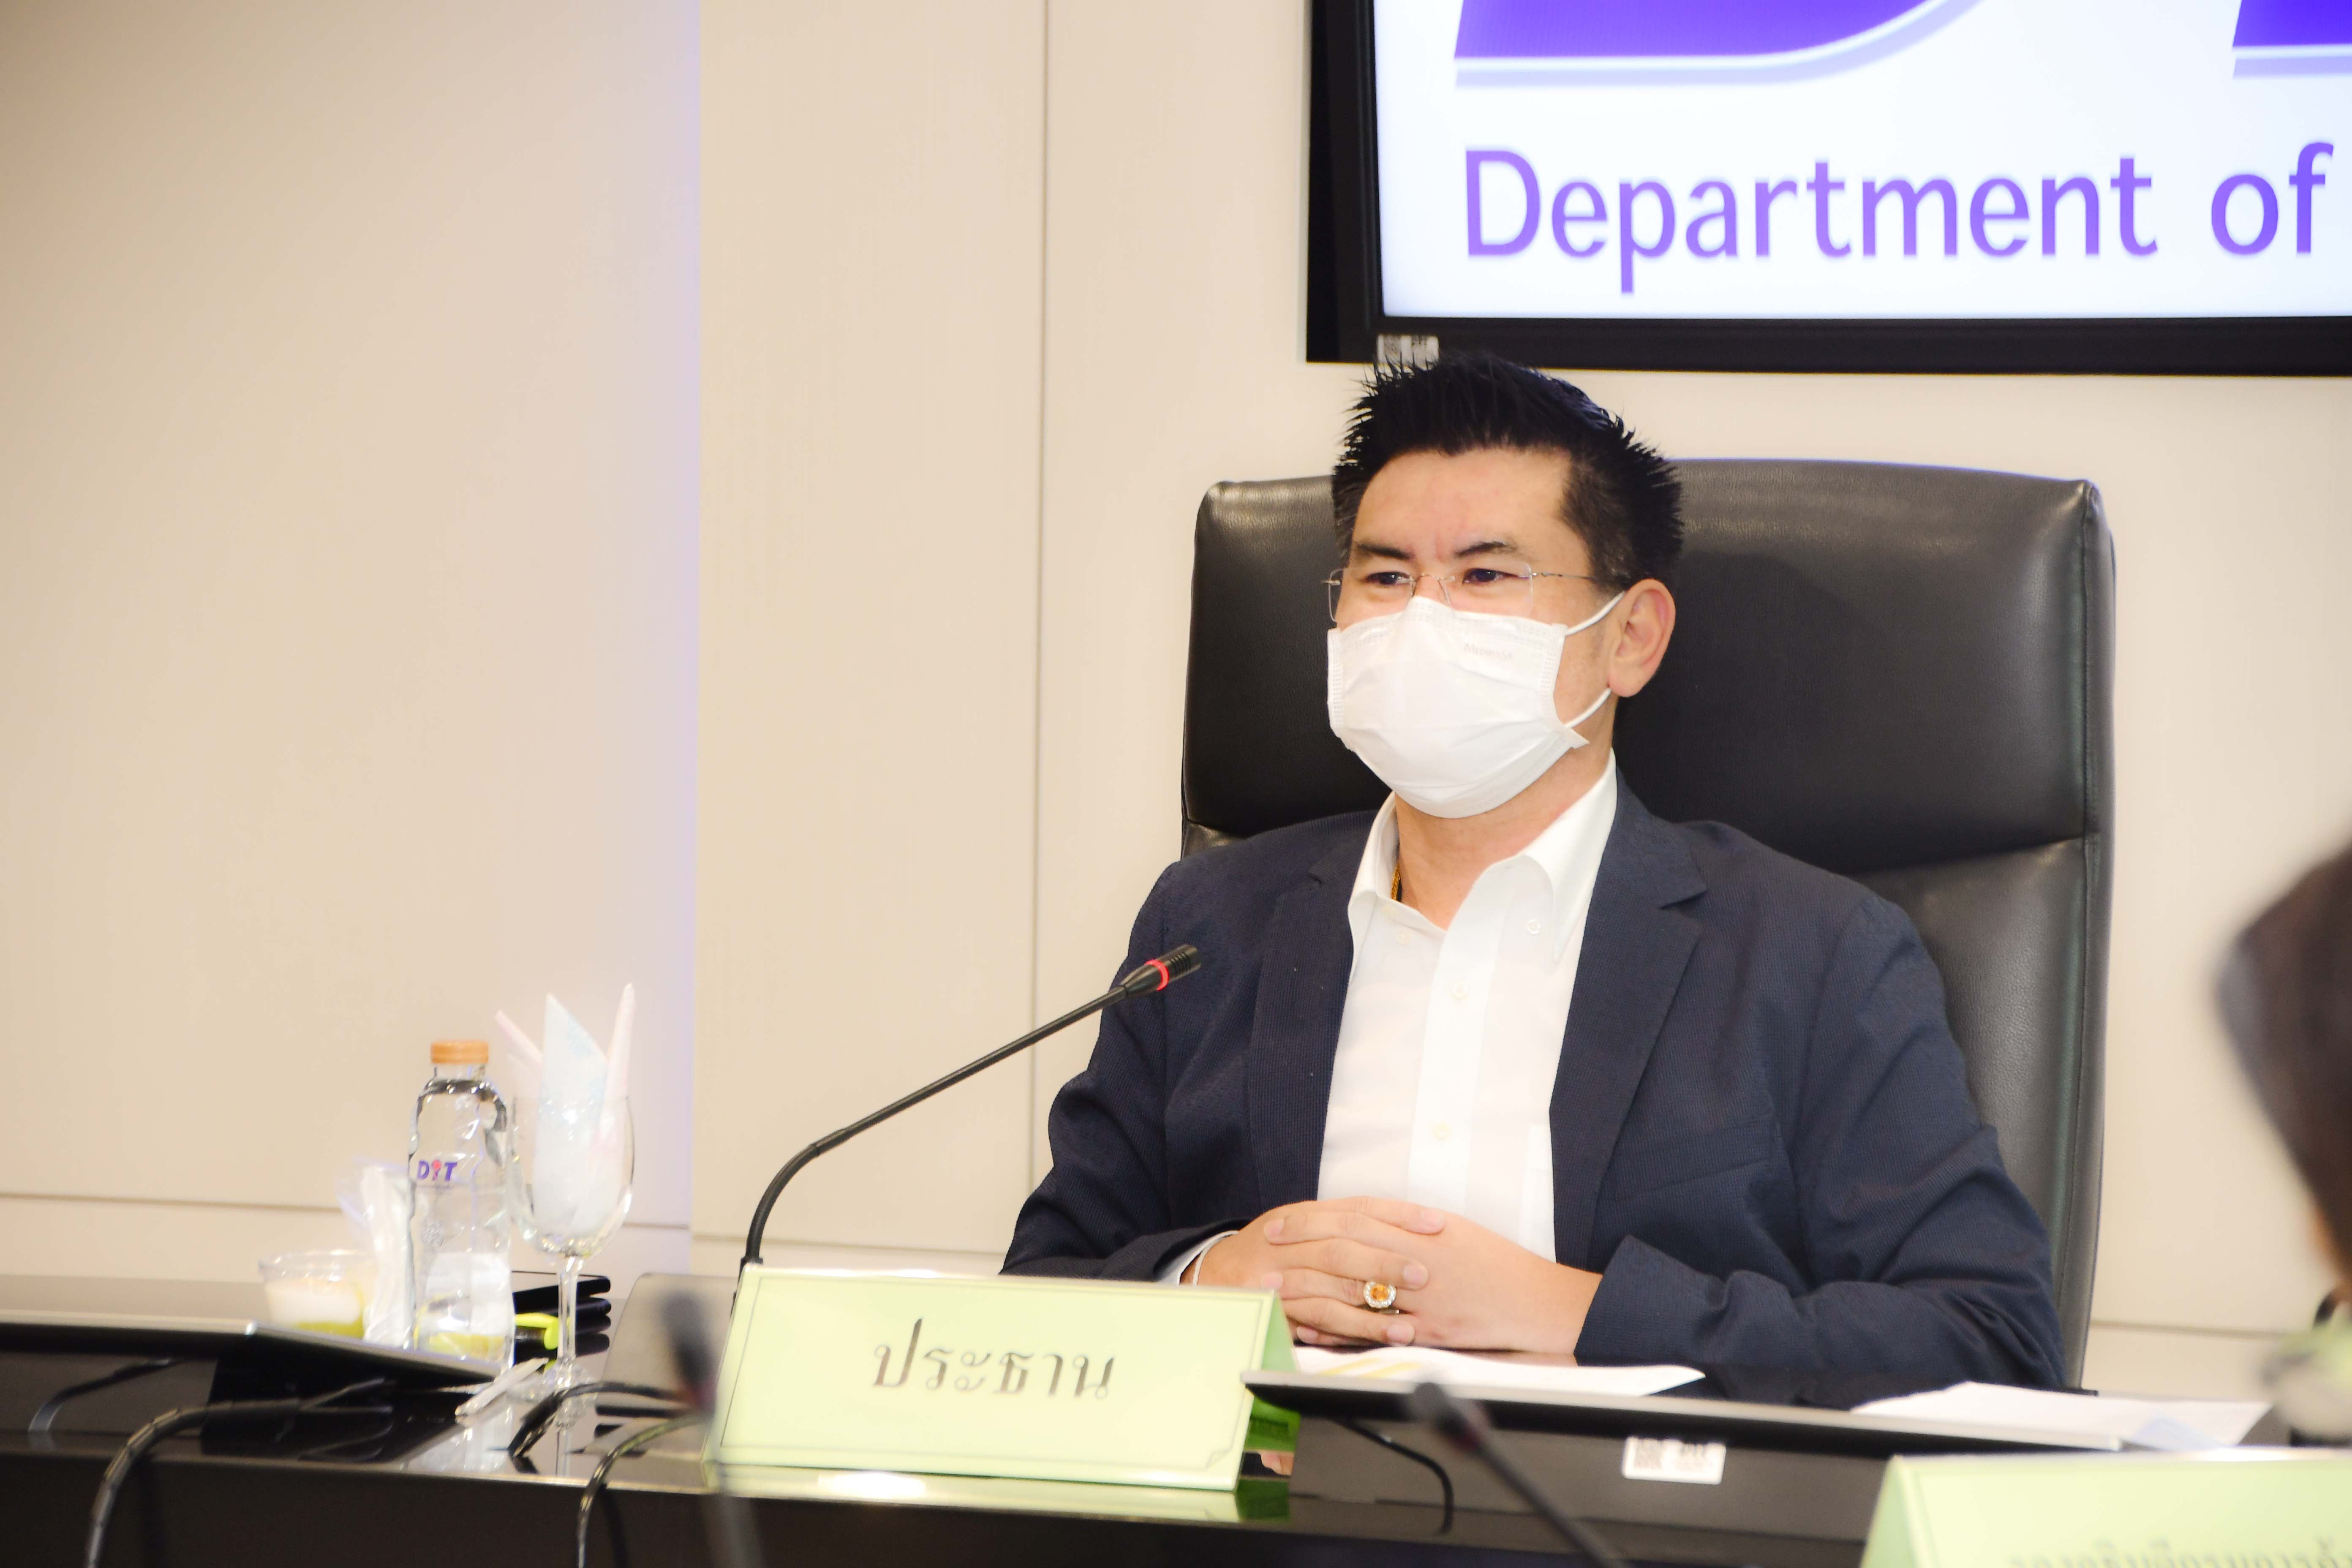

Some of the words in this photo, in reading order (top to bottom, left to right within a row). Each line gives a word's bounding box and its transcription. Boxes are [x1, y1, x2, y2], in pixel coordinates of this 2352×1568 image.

[1465, 148, 2159, 295] Department
[2210, 140, 2335, 257] of
[871, 1317, 1116, 1400] ประธาน
